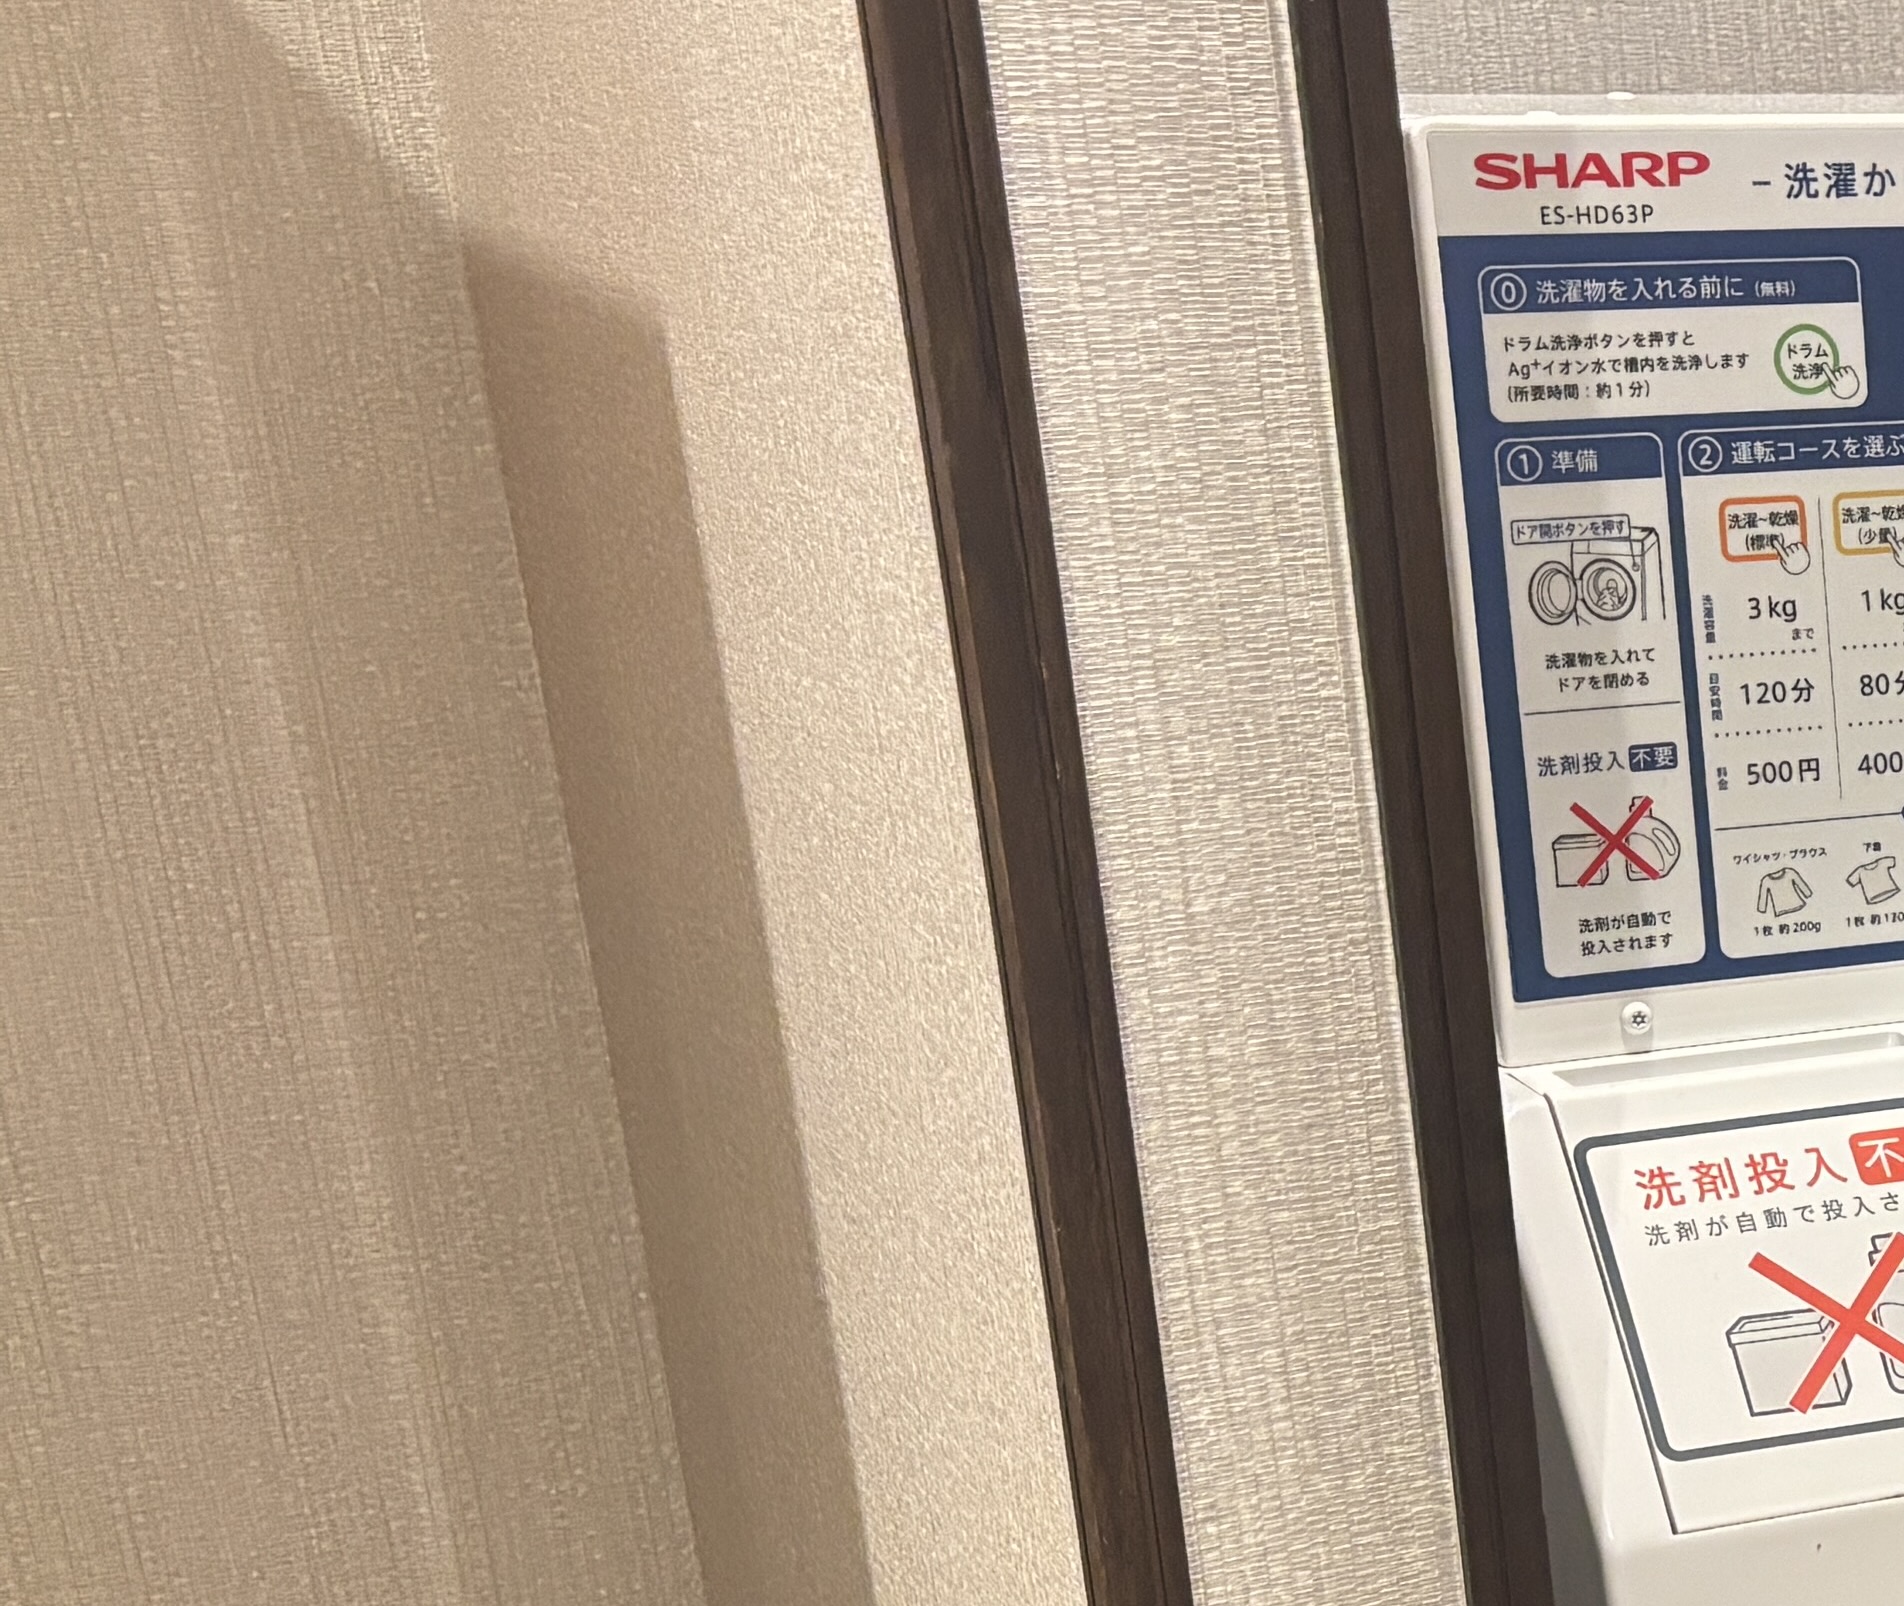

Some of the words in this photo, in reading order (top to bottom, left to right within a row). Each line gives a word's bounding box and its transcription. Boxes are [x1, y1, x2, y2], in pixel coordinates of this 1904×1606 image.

[1474, 151, 1710, 190] SHARP
[1541, 204, 1655, 226] ES-HD63P
[1536, 276, 1745, 304] 洗濯物を入れる前に
[1502, 329, 1696, 353] ドラム洗浄ボタンを押すと
[1786, 342, 1829, 360] ドラム
[1792, 362, 1824, 381] 洗浄
[1551, 449, 1598, 474] 準備
[1515, 519, 1626, 540] ドア開ボタンを押す
[1792, 628, 1815, 641] まで
[1545, 647, 1656, 671] 洗濯物を入れて
[1557, 671, 1650, 693] ドアを閉める
[1739, 676, 1816, 706] 120分
[1537, 750, 1626, 778] 洗剤投入
[1630, 745, 1677, 770] 不要
[1746, 757, 1821, 785] 500円
[1578, 909, 1672, 934] 洗剤が自動で
[1581, 931, 1673, 958] 投入されます
[1634, 1146, 1848, 1210] 洗剤投入
